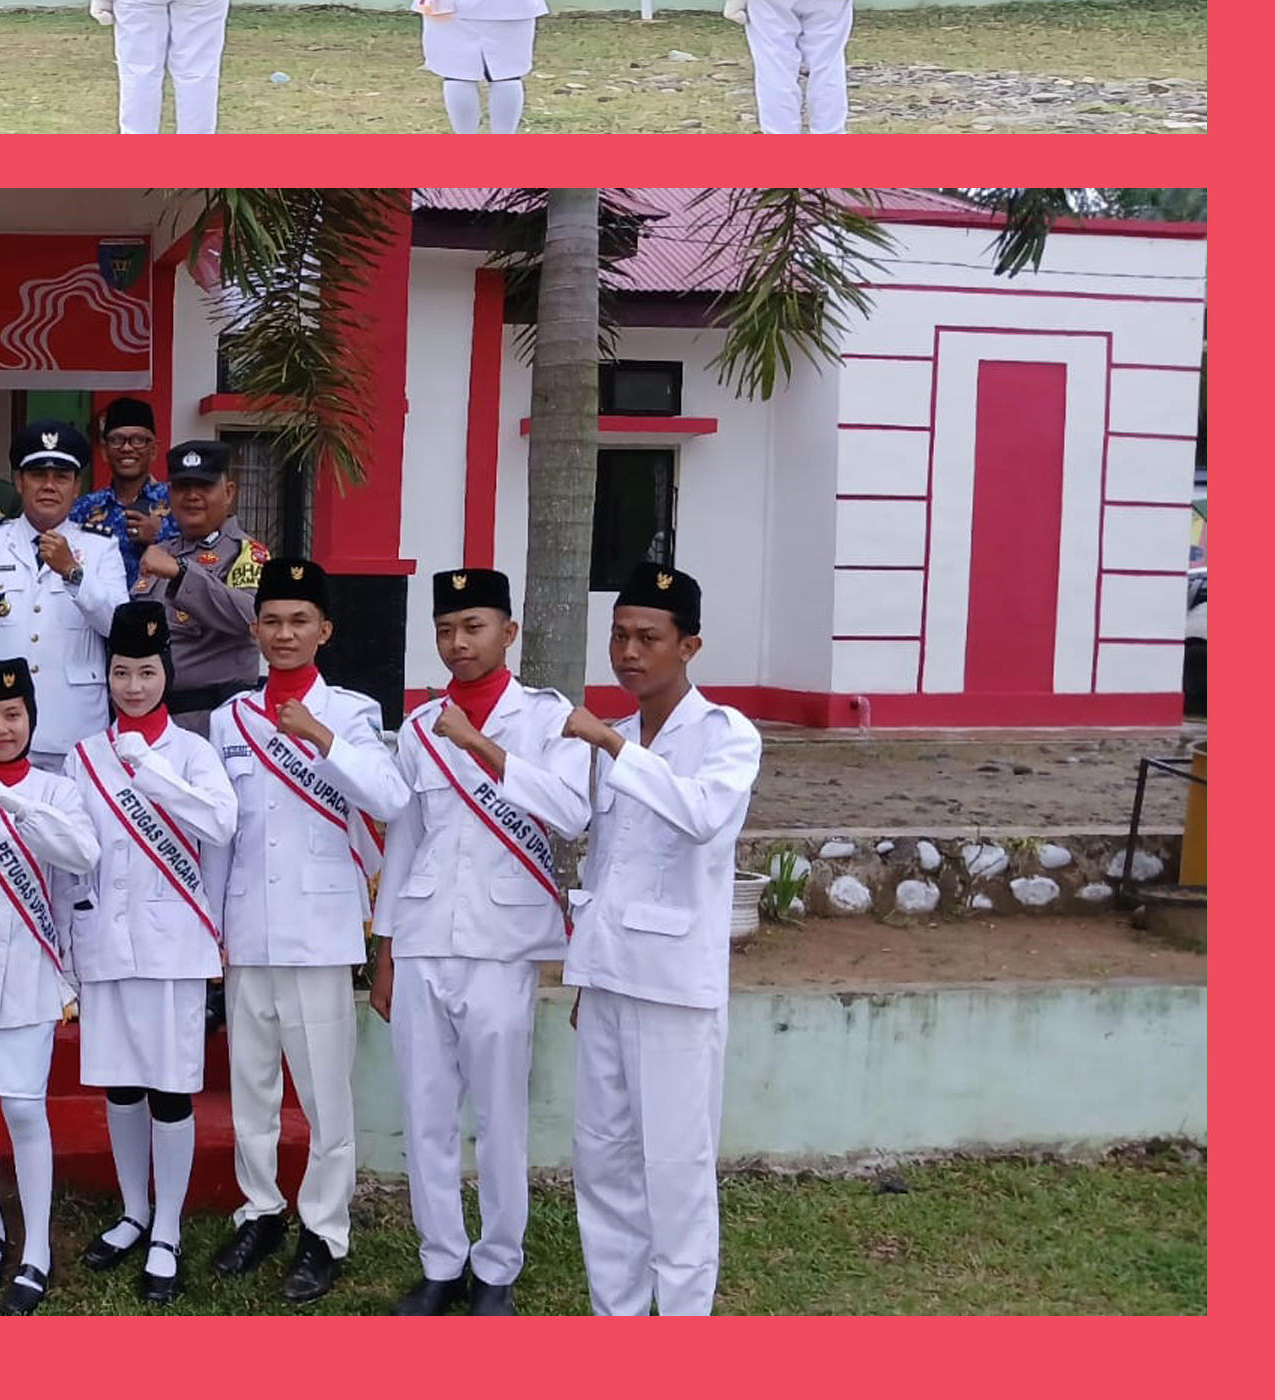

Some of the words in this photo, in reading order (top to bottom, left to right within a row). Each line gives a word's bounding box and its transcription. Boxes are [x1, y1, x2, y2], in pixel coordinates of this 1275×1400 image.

[266, 736, 315, 788] PETUGAS
[116, 787, 159, 844] PETUGAS
[157, 832, 201, 893] UPACARA
[474, 782, 531, 840] PETUGAS
